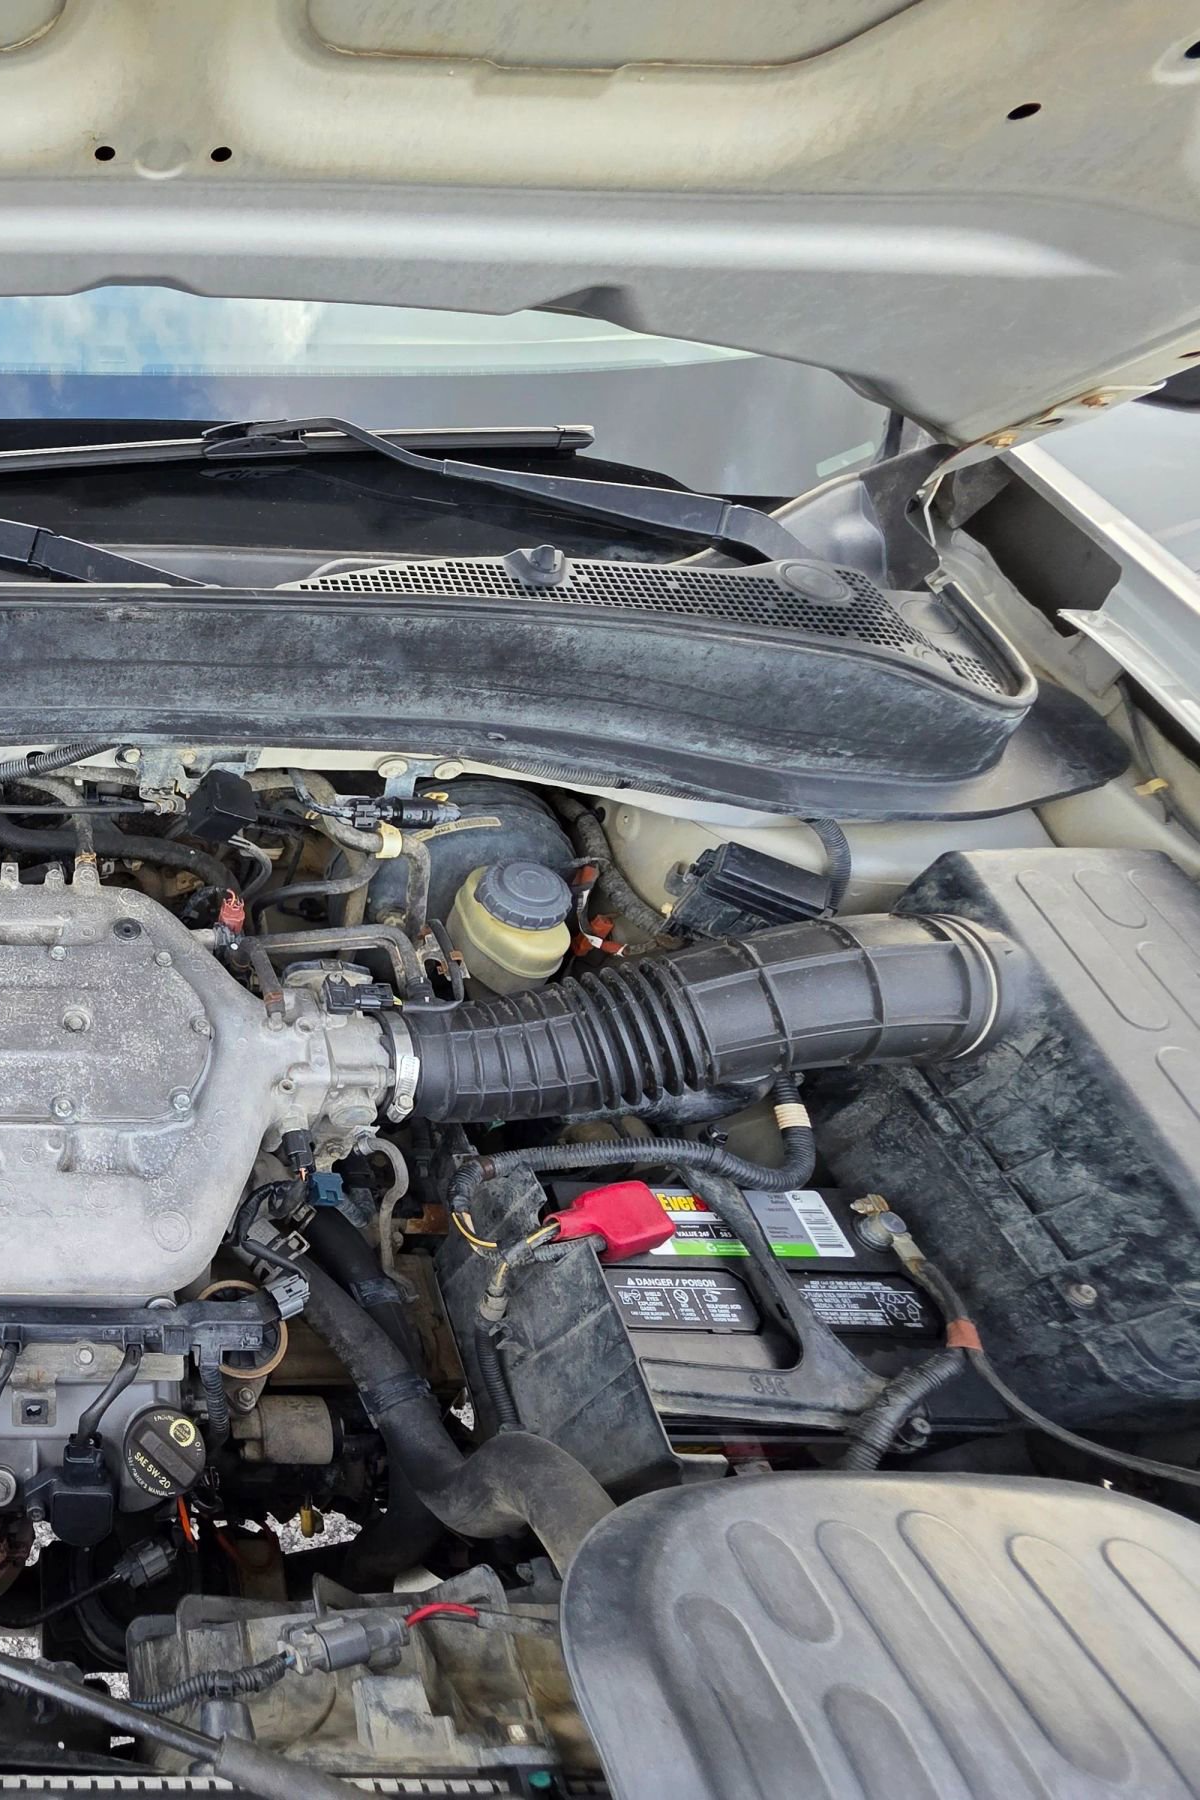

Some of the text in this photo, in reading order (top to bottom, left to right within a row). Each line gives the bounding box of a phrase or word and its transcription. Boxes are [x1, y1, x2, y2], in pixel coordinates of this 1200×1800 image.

[656, 1193, 710, 1211] EverS
[635, 1278, 673, 1286] DANGER
[682, 1279, 717, 1287] POISON
[134, 1452, 171, 1489] SAE 5W-20
[148, 1486, 168, 1497] MANUAL
